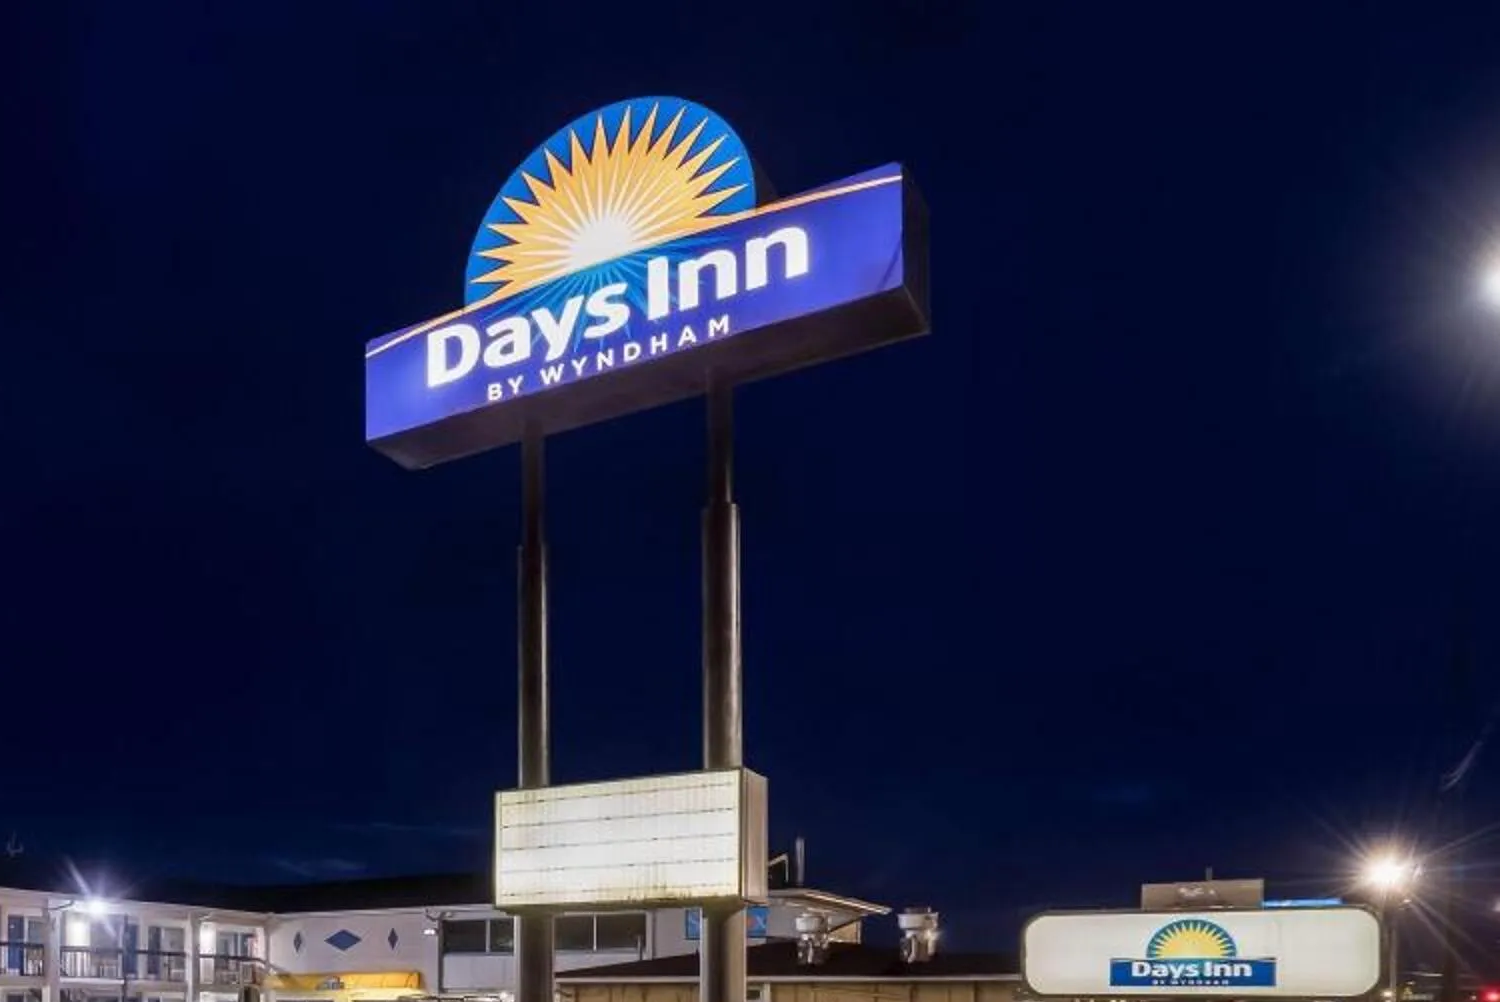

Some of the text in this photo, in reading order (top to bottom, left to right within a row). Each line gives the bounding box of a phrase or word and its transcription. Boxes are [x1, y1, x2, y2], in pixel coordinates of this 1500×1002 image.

[425, 225, 811, 389] Days Inn
[486, 314, 731, 402] BY WYNDHAM
[1131, 961, 1253, 979] Days Inn
